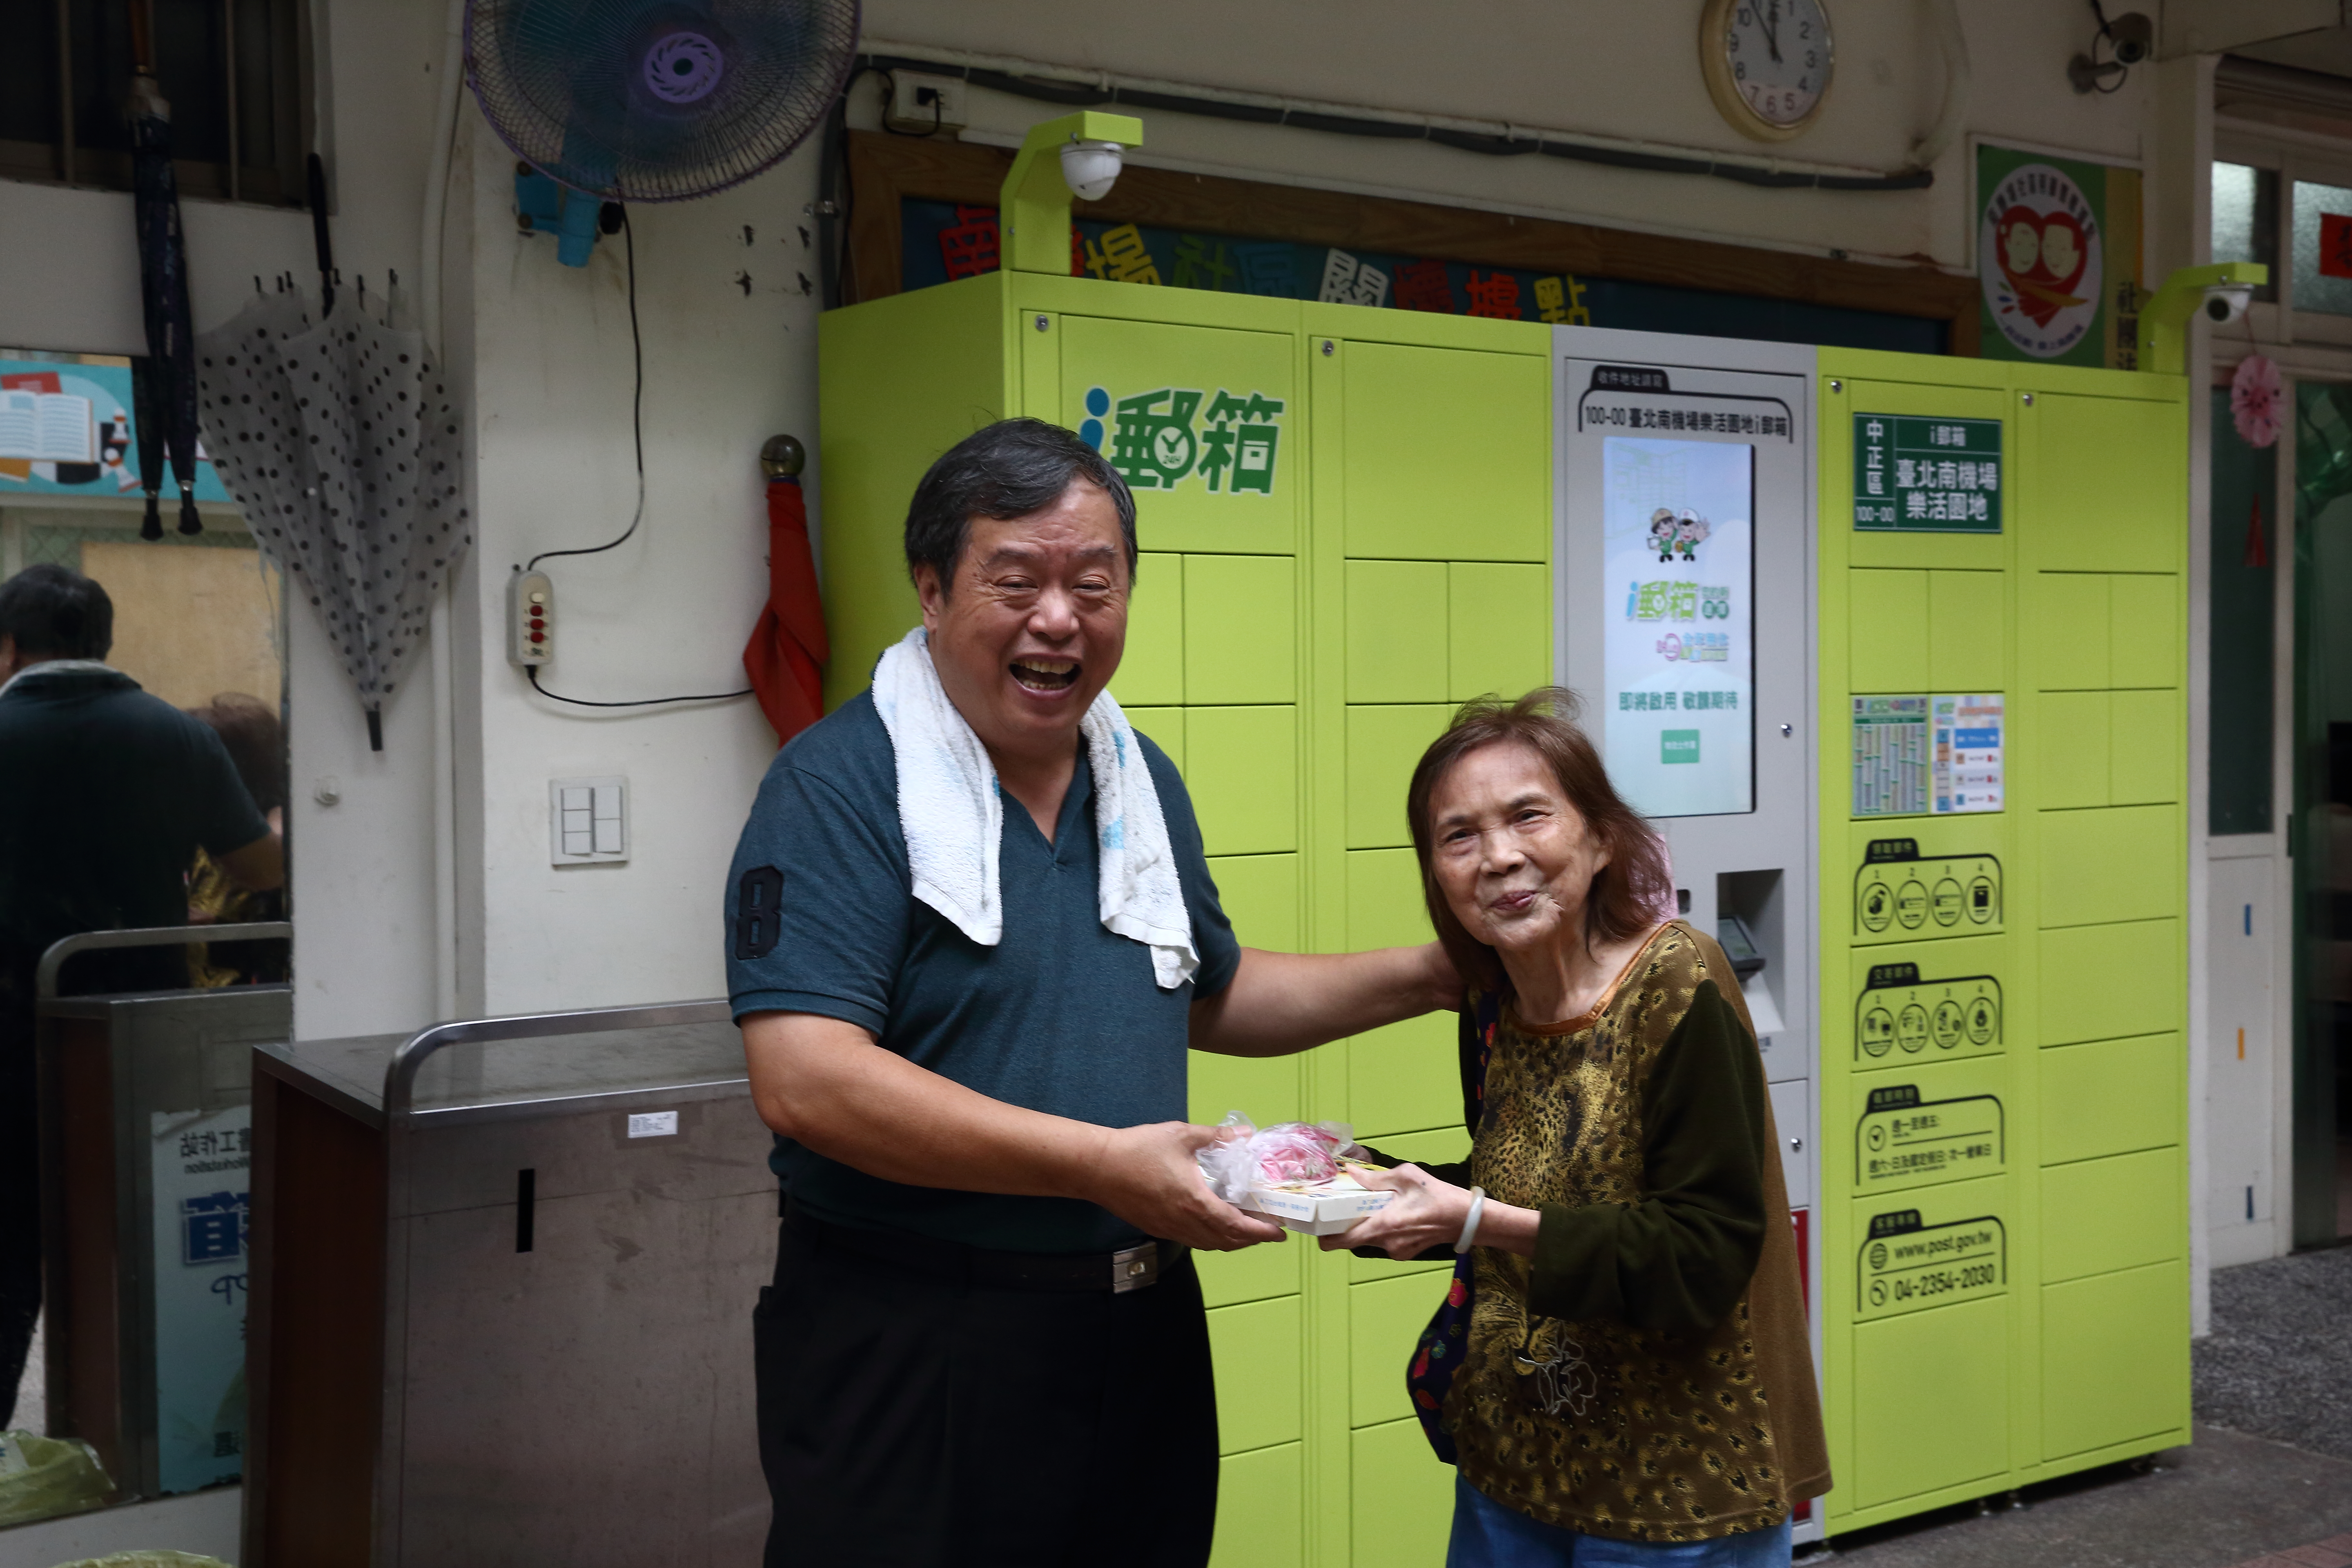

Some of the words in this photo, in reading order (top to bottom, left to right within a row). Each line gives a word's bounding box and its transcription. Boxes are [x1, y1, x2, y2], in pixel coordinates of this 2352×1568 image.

[1800, 21, 1810, 39] 2
[1730, 33, 1739, 52] 9
[1806, 50, 1816, 69] 3
[1735, 62, 1746, 80] 8
[1798, 76, 1808, 91] 4
[1751, 85, 1760, 108] 7
[1767, 95, 1776, 114] 6
[1784, 93, 1795, 111] 5
[1586, 406, 1626, 426] 100-00
[1930, 425, 1966, 447] i郵箱
[1866, 419, 1884, 495] 中正區
[1896, 459, 1998, 491] 臺北南機場
[1855, 506, 1895, 522] 100-00
[1906, 491, 1989, 521] 樂活園地
[1910, 867, 1915, 877] 2
[1910, 991, 1915, 1001] 2
[1894, 1231, 1993, 1259] www.post.gov.tw
[1895, 1264, 1994, 1301] 04-2354-2030
